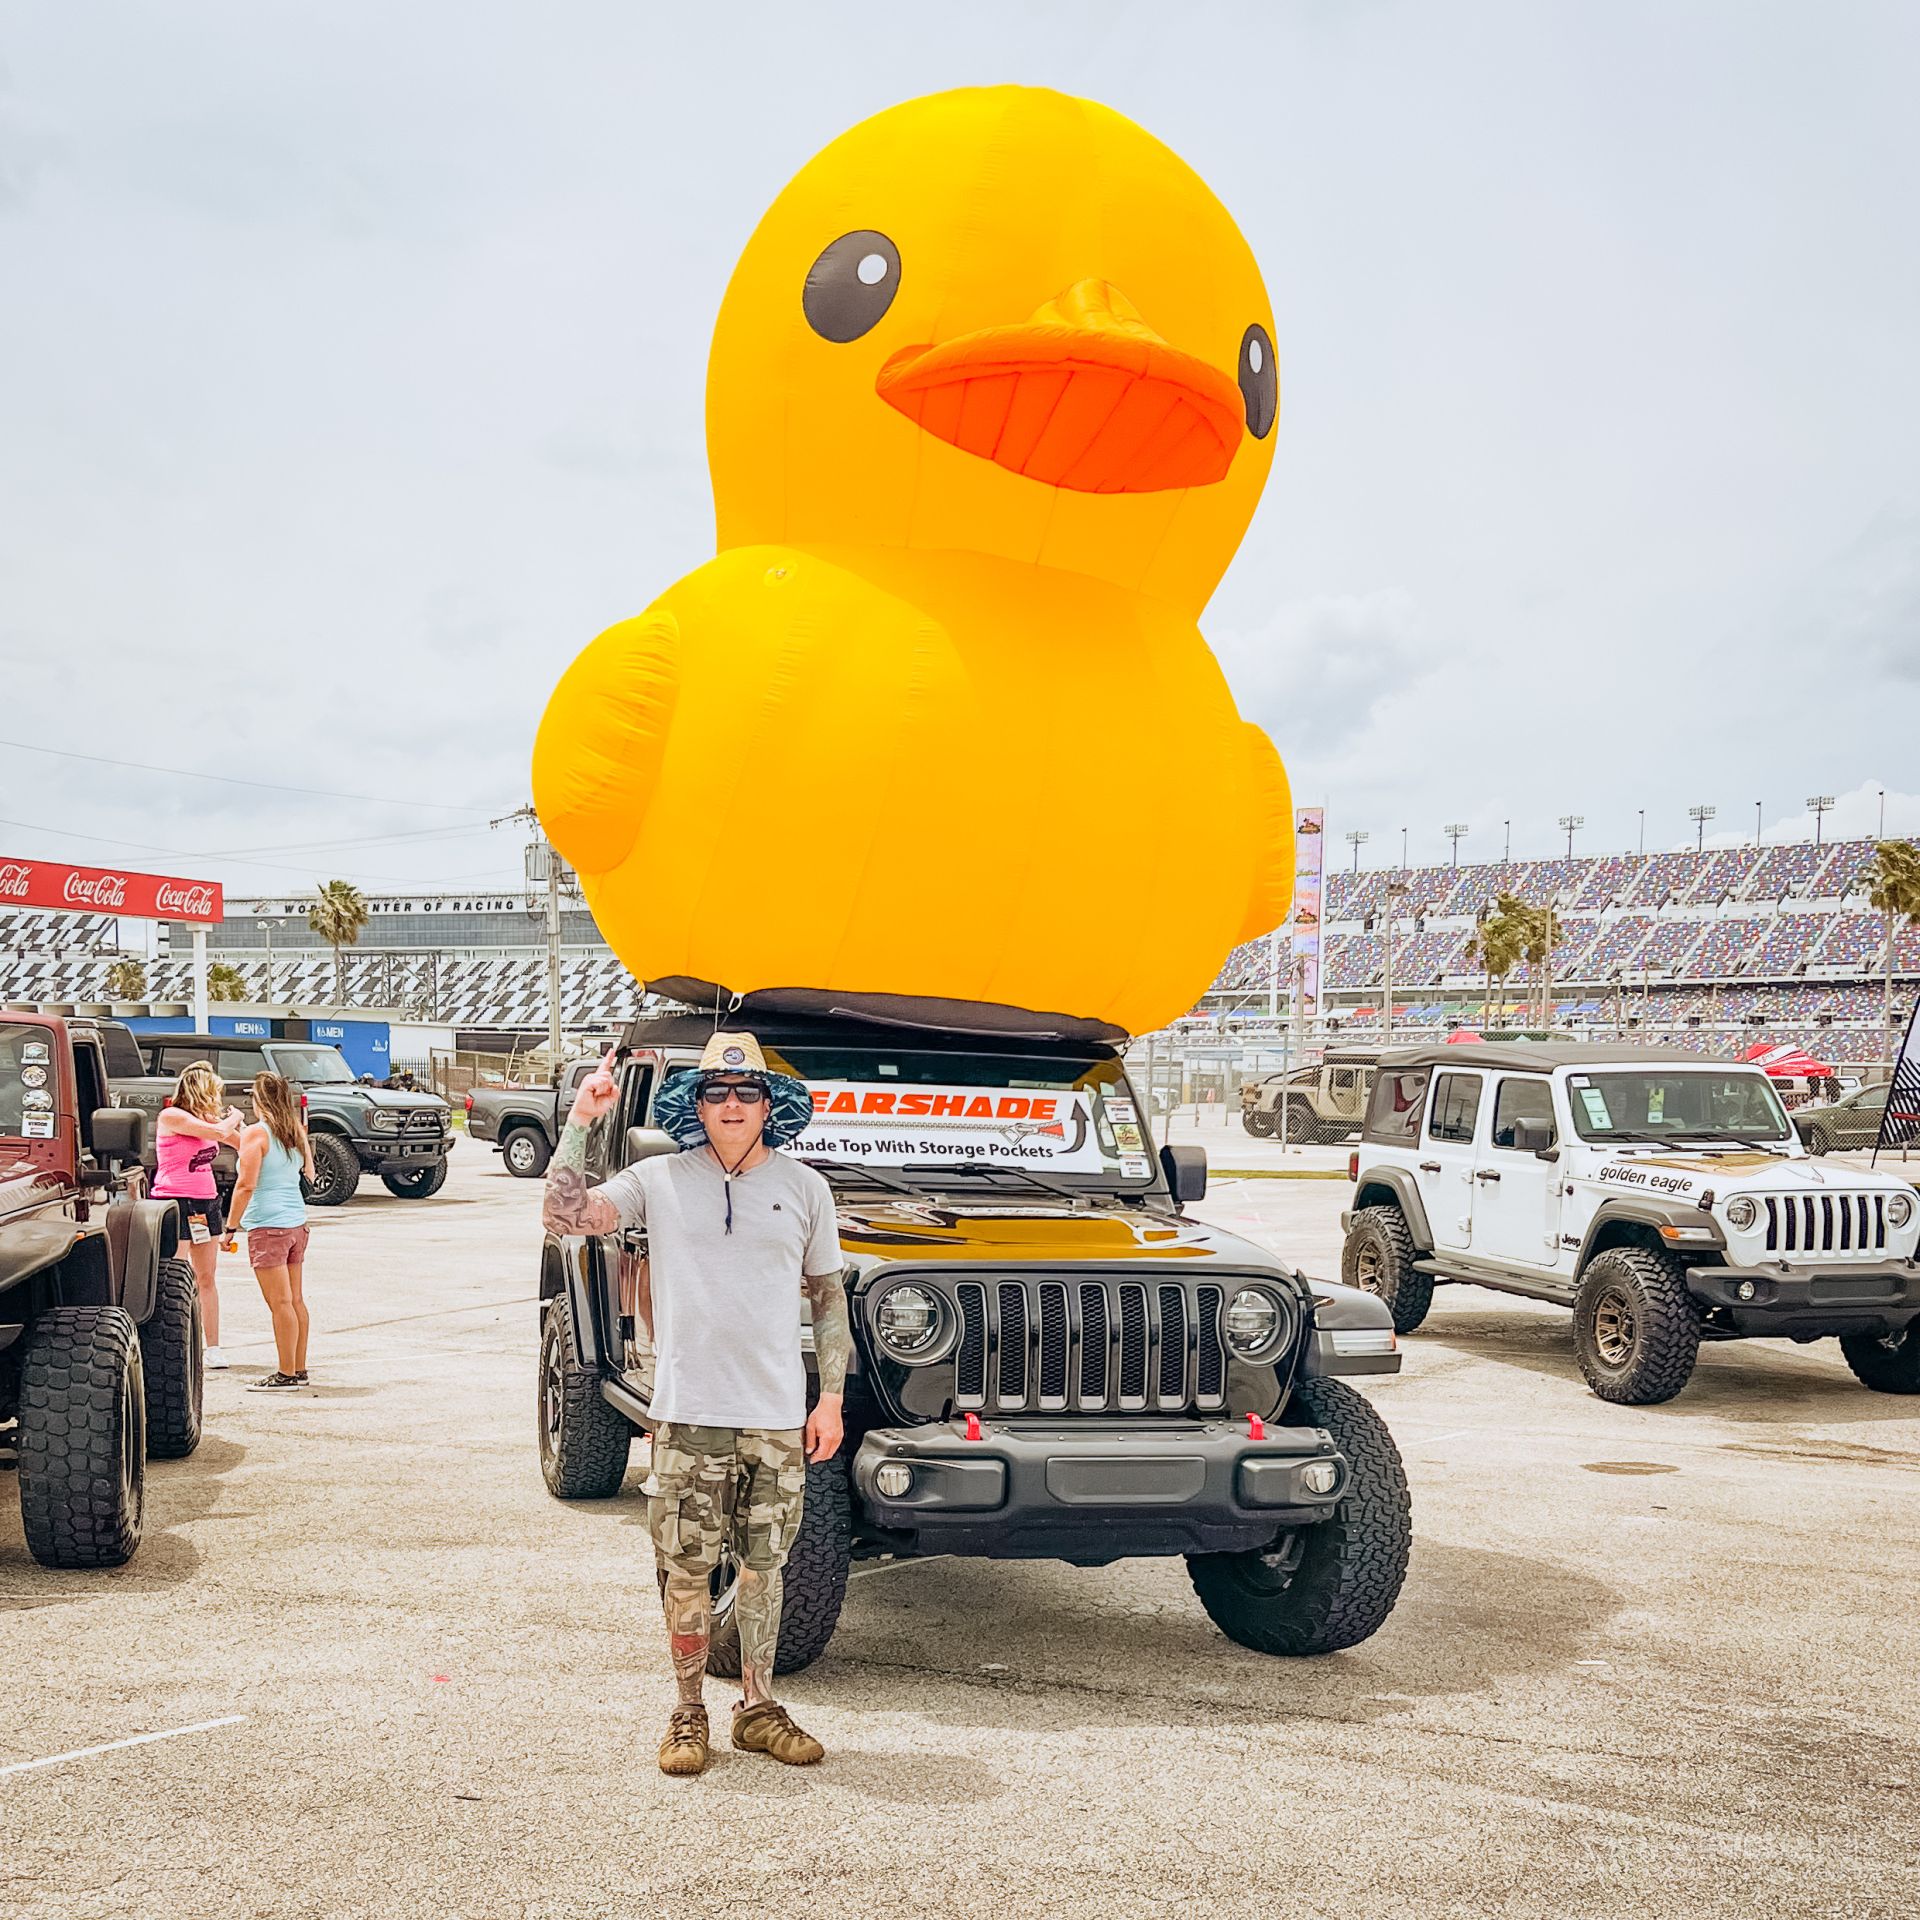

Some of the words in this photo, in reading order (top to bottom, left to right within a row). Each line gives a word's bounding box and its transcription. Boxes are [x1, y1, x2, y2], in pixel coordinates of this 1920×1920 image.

[63, 871, 128, 907] Coca-Cola
[155, 882, 215, 916] Coca-Cola
[362, 902, 412, 913] ENTER
[423, 902, 443, 912] OF
[452, 900, 514, 912] RACING
[234, 1022, 255, 1035] MEN
[325, 1027, 344, 1038] MEN
[812, 1091, 1057, 1120] EARSHADE
[783, 1137, 837, 1152] Shade
[839, 1139, 872, 1156] Top
[875, 1139, 915, 1155] With
[919, 1142, 986, 1158] Storage
[988, 1143, 1054, 1158] Pockets
[1600, 1166, 1647, 1185] golden
[1650, 1174, 1693, 1193] eagle
[1561, 1233, 1582, 1248] Jeep
